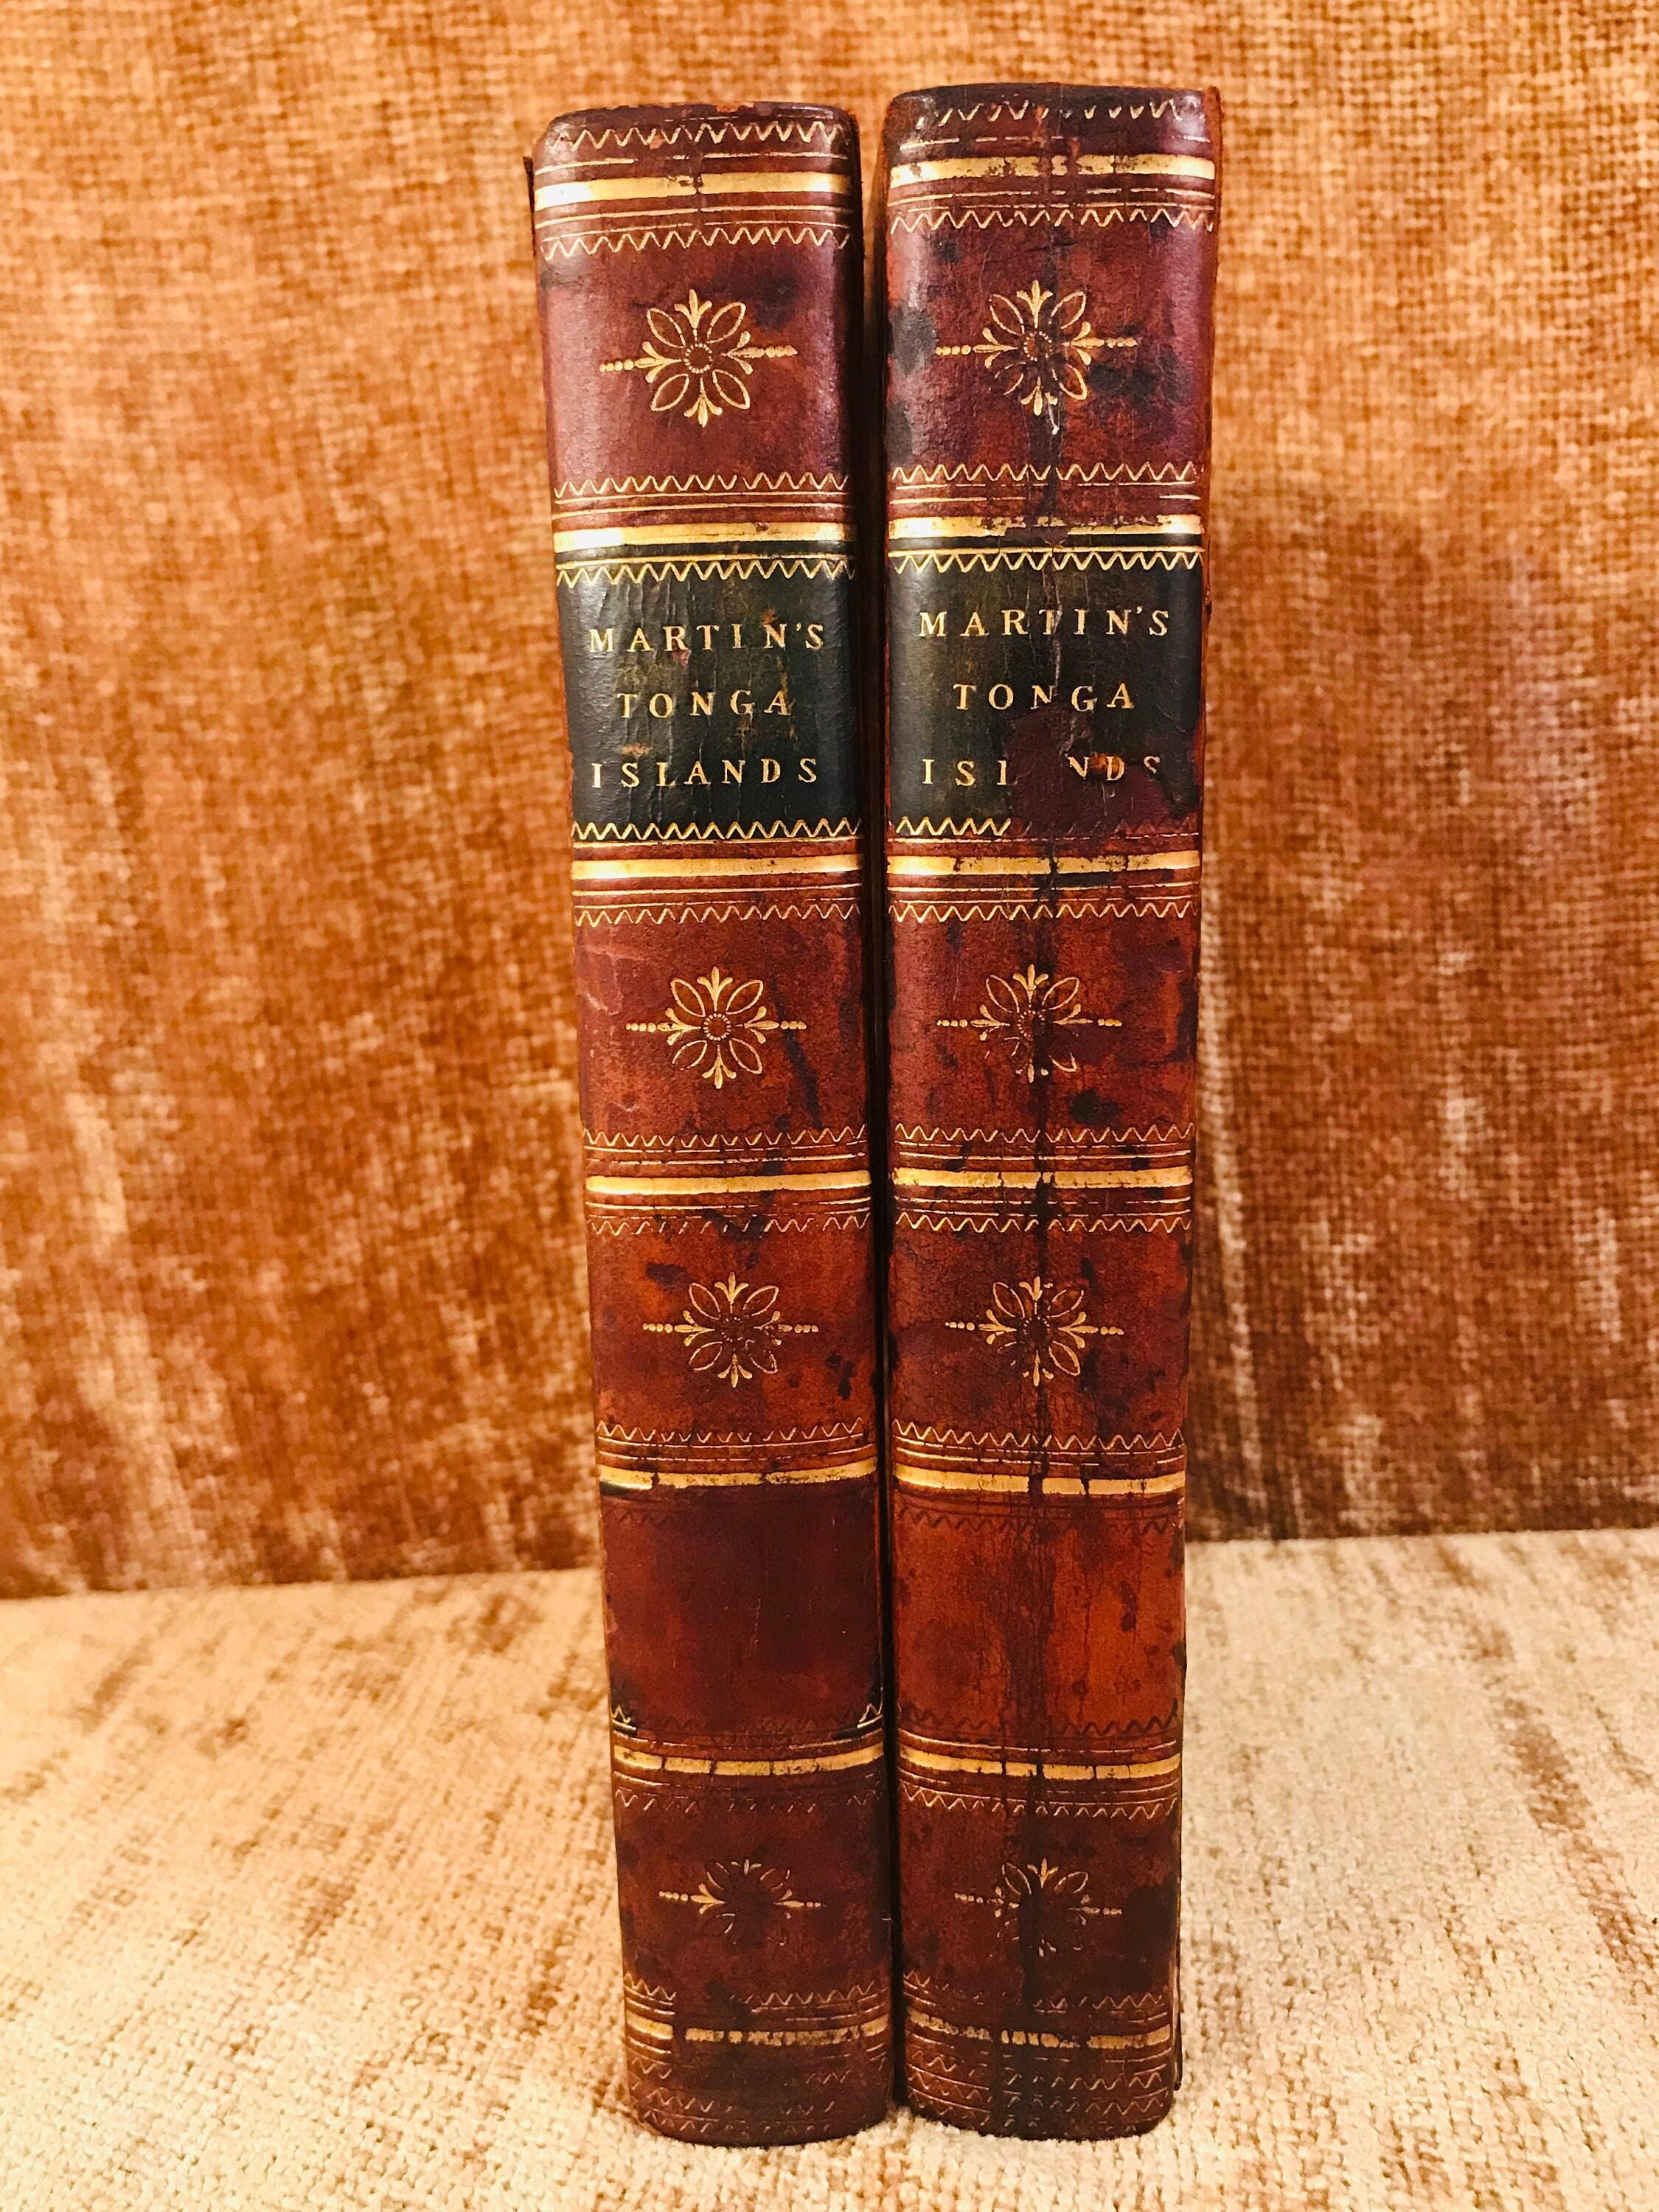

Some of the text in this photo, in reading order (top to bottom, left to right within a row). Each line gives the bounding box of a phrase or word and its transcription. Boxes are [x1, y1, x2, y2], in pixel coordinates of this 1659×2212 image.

[918, 606, 1169, 637] MARTIN'S
[589, 623, 824, 653] MARTIN'S
[617, 689, 793, 719] TONGA
[953, 682, 1135, 712] TONGA
[591, 758, 818, 788] ISLANDS
[922, 756, 1161, 787] ISLNDS
